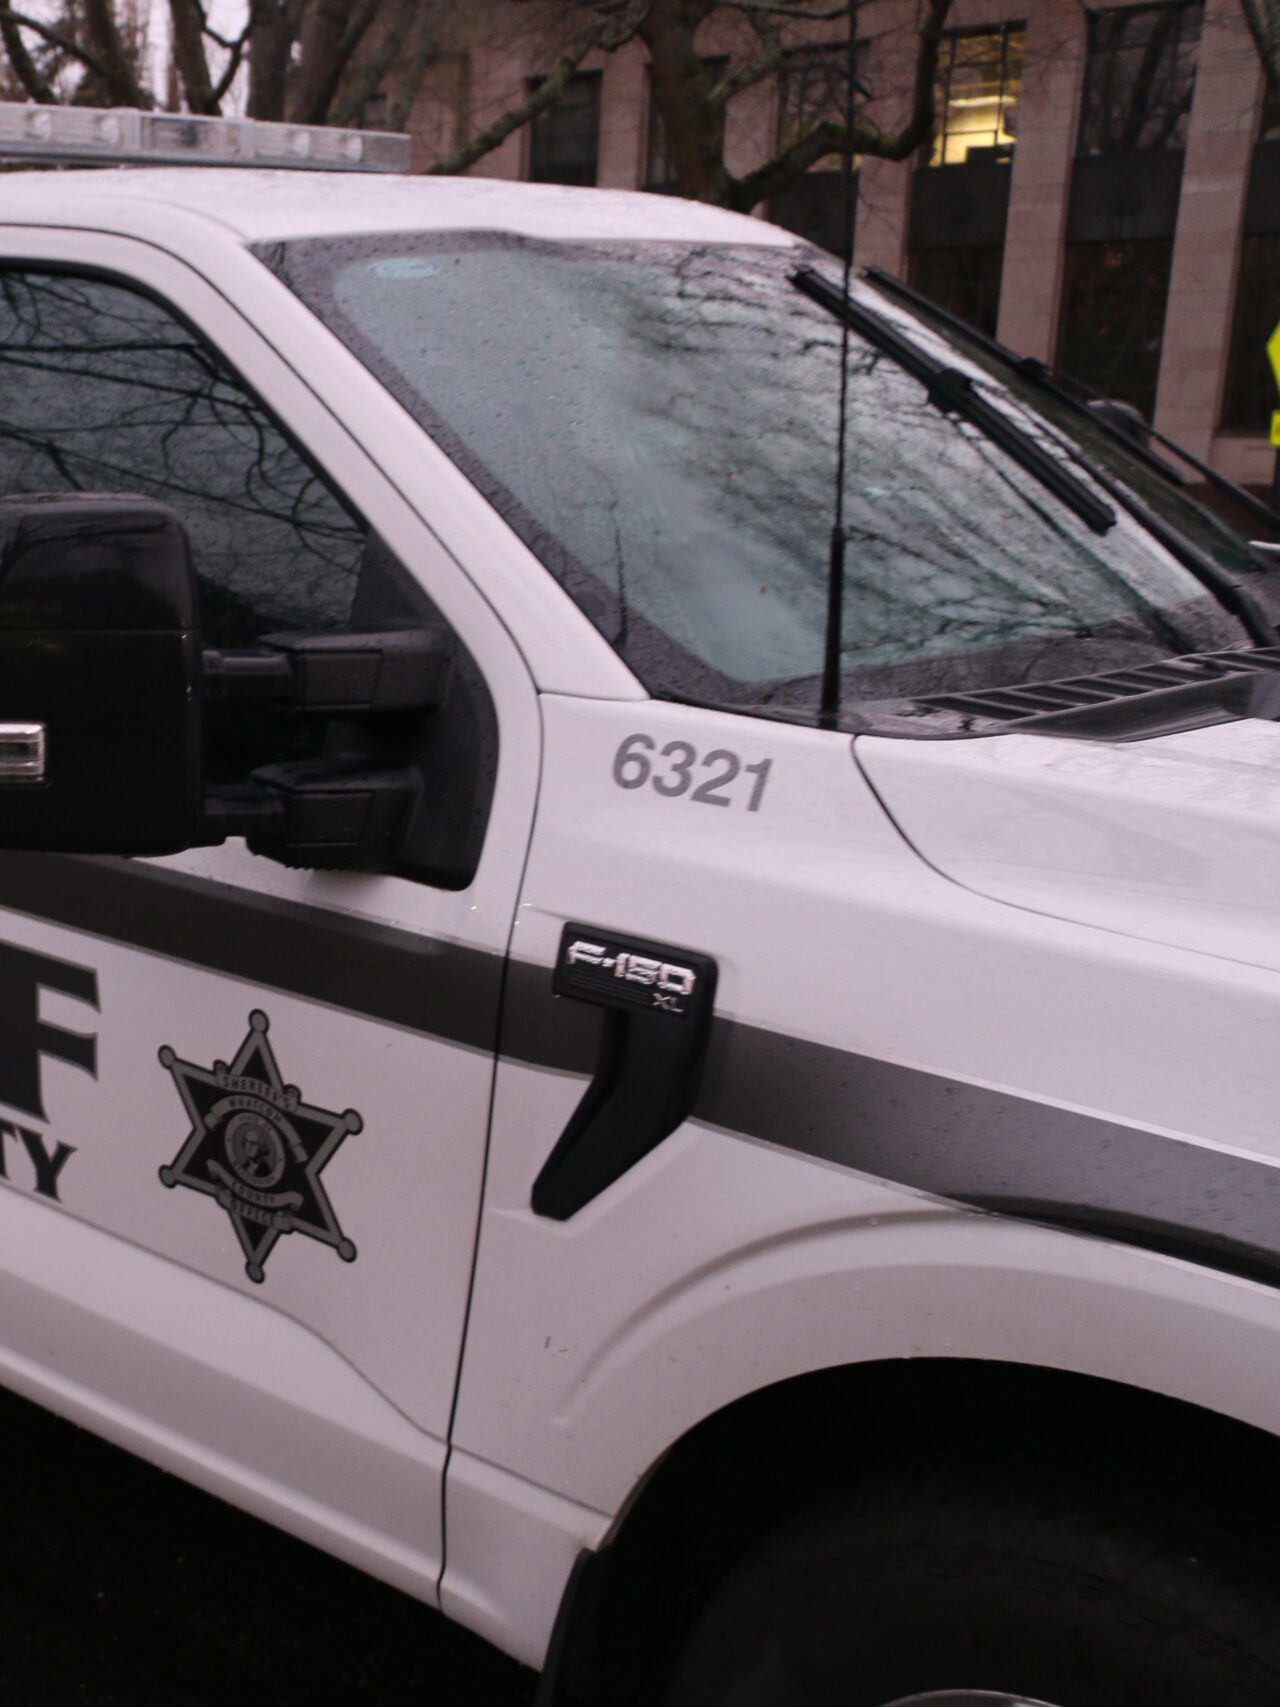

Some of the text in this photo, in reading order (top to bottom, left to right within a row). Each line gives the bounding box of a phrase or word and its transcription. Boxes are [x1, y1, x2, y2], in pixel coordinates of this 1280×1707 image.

[612, 733, 773, 812] 6321
[568, 940, 696, 995] F-150
[652, 993, 684, 1013] XL
